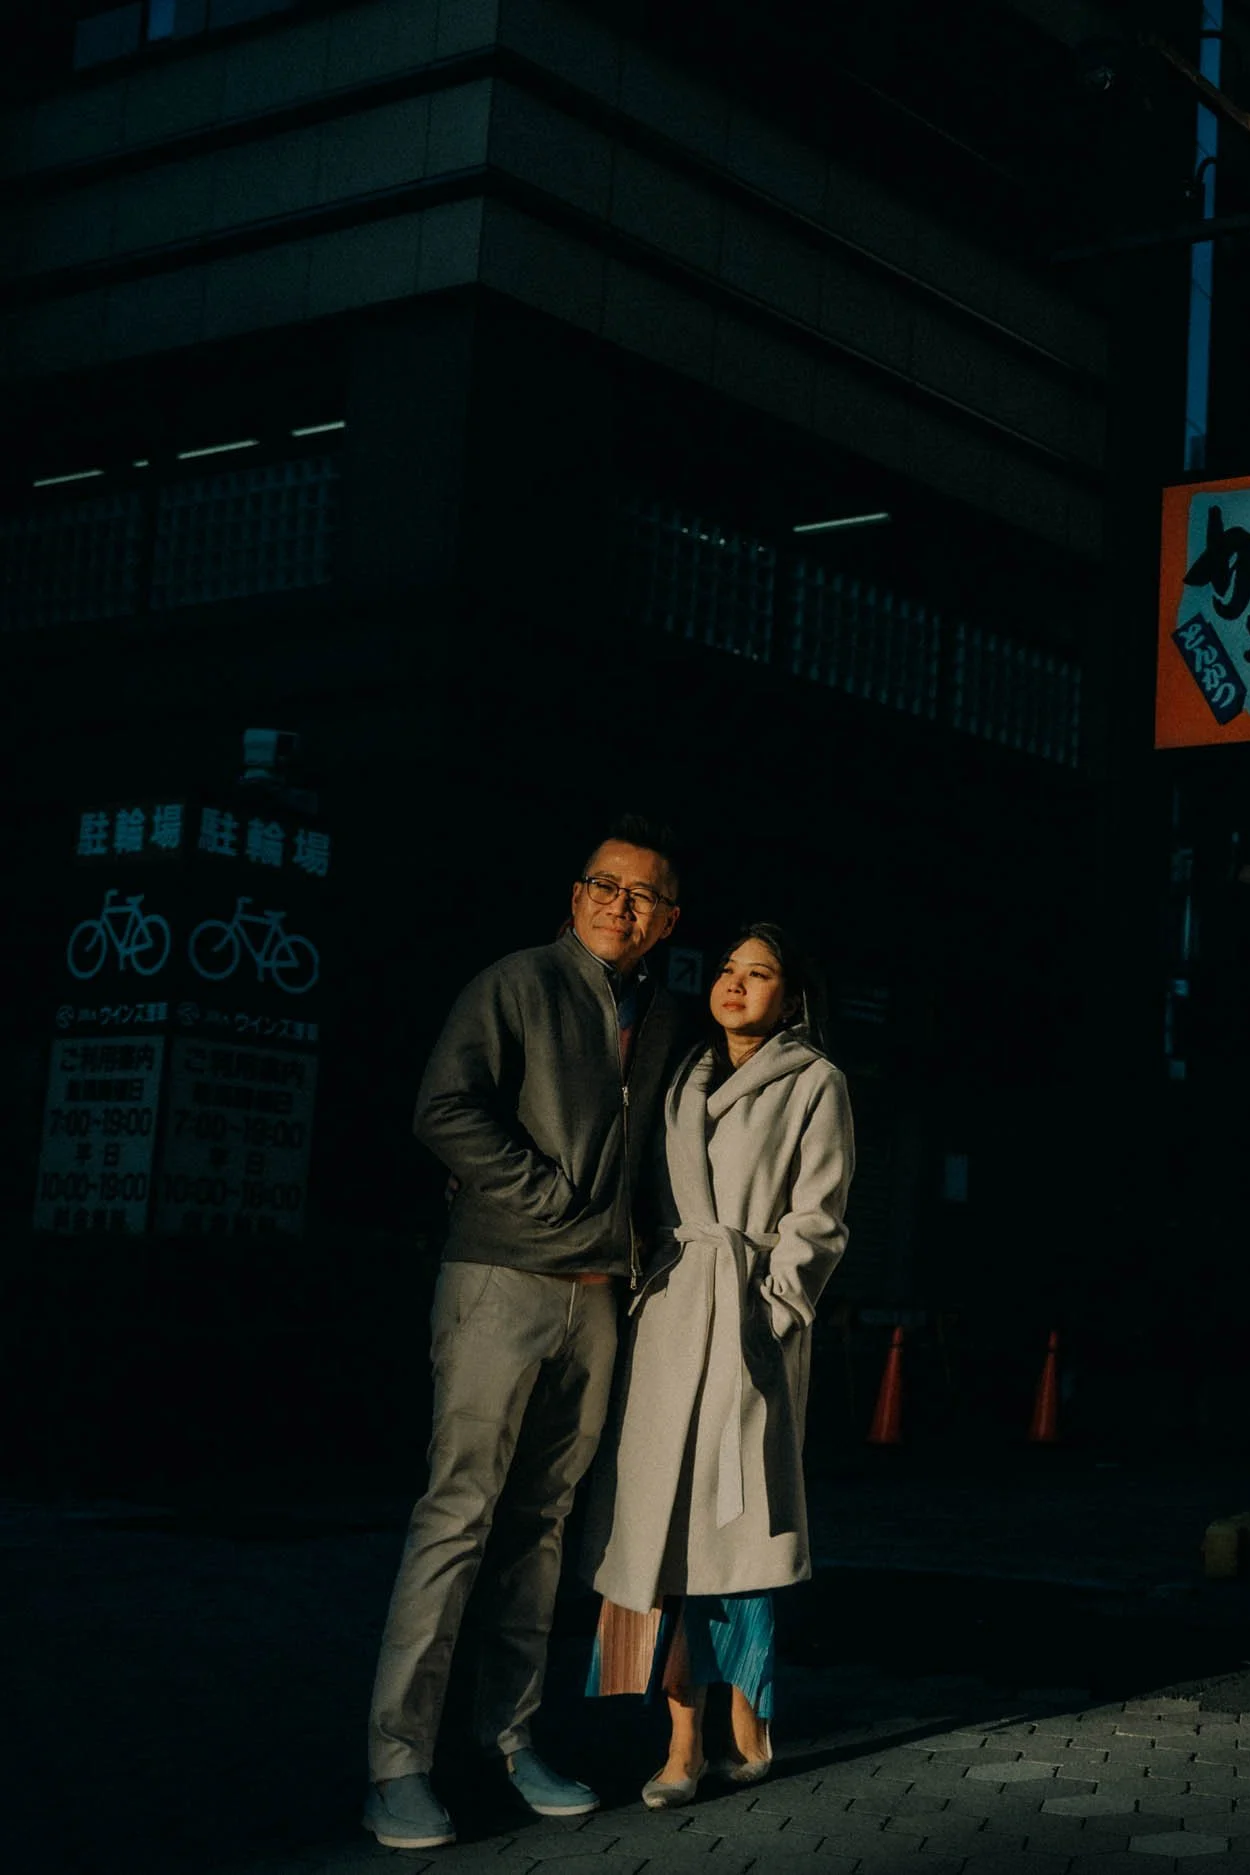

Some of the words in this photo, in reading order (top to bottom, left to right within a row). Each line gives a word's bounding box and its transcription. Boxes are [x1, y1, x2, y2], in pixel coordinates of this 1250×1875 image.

[1178, 623, 1237, 709] とんかつ
[77, 803, 184, 857] 駐輪場
[198, 807, 331, 877] 駐輪場
